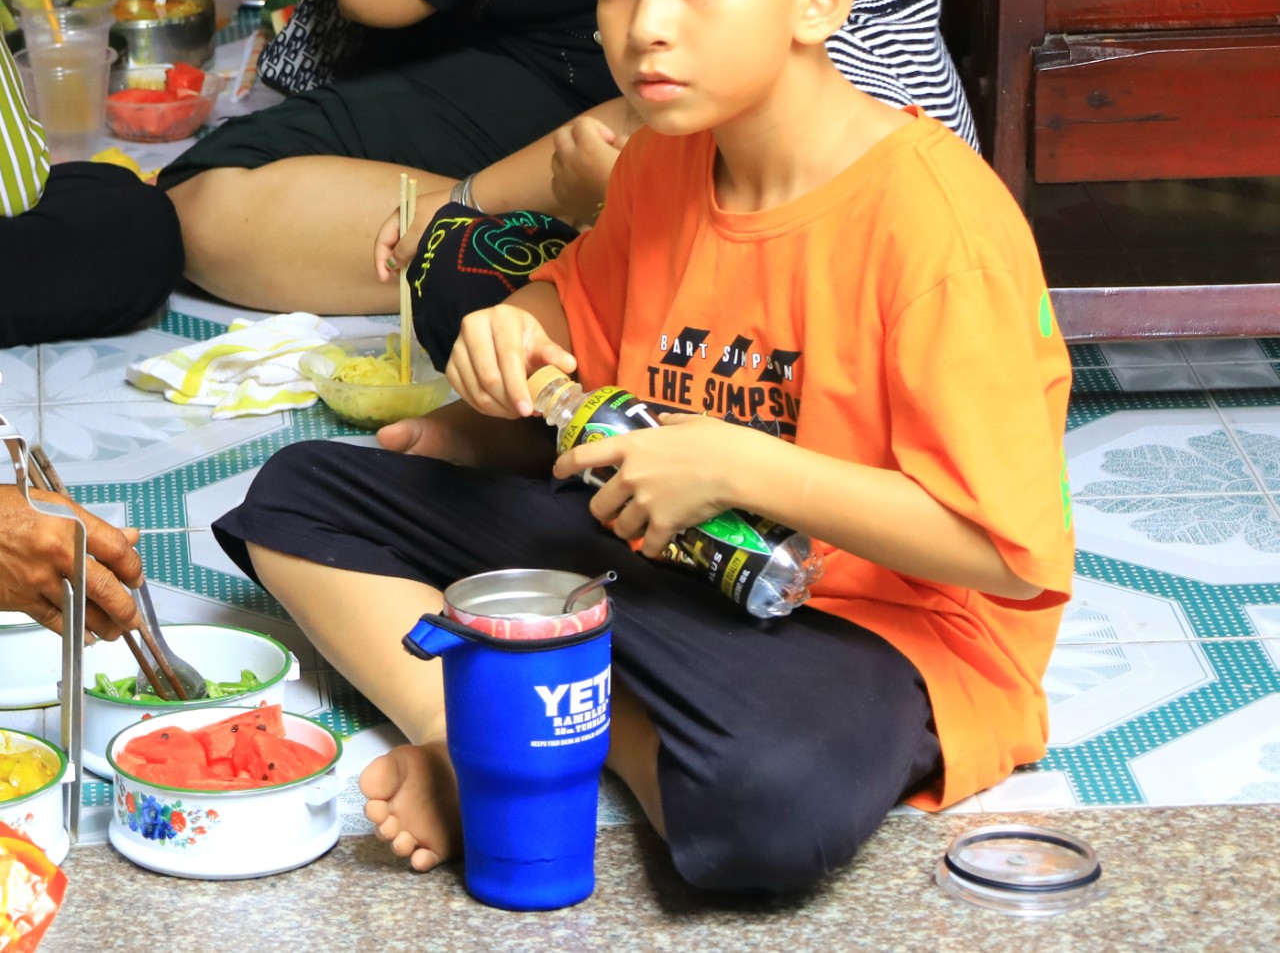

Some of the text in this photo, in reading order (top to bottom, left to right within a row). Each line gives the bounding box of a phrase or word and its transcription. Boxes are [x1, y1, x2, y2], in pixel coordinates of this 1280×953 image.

[660, 334, 708, 359] BART
[647, 365, 694, 406] THE
[564, 424, 578, 441] TEA
[533, 663, 612, 717] YETI
